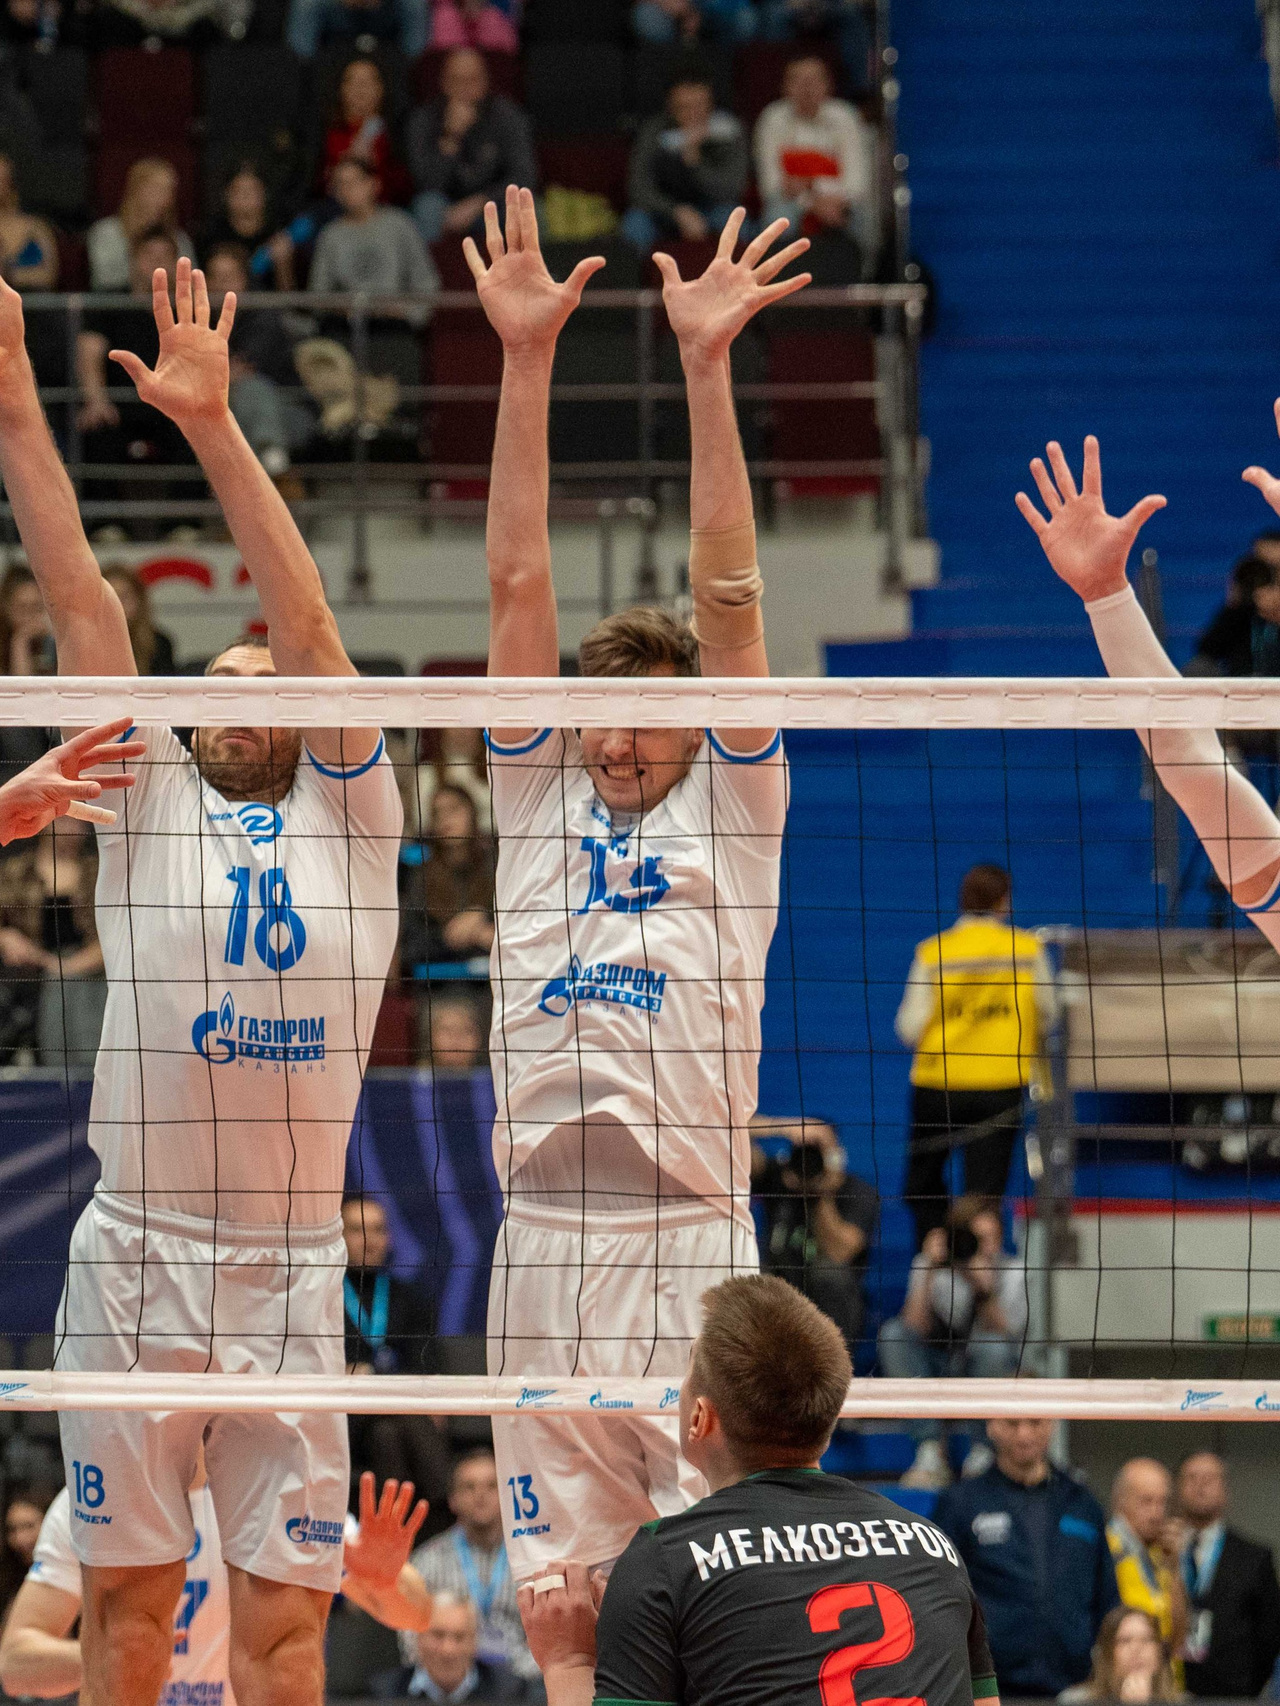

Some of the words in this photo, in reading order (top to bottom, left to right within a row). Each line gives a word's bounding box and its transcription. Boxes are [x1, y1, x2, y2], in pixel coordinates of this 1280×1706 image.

[223, 865, 307, 973] 18
[238, 1015, 325, 1044] ГАЗПРОМ
[239, 1044, 325, 1060] ТРАНСГАЗ
[238, 1060, 326, 1074] КАЗАНЬ
[72, 1460, 106, 1508] 18
[507, 1474, 540, 1520] 13
[688, 1519, 960, 1582] МЕЛКОЗЕРОВ
[805, 1580, 929, 1706] 2
